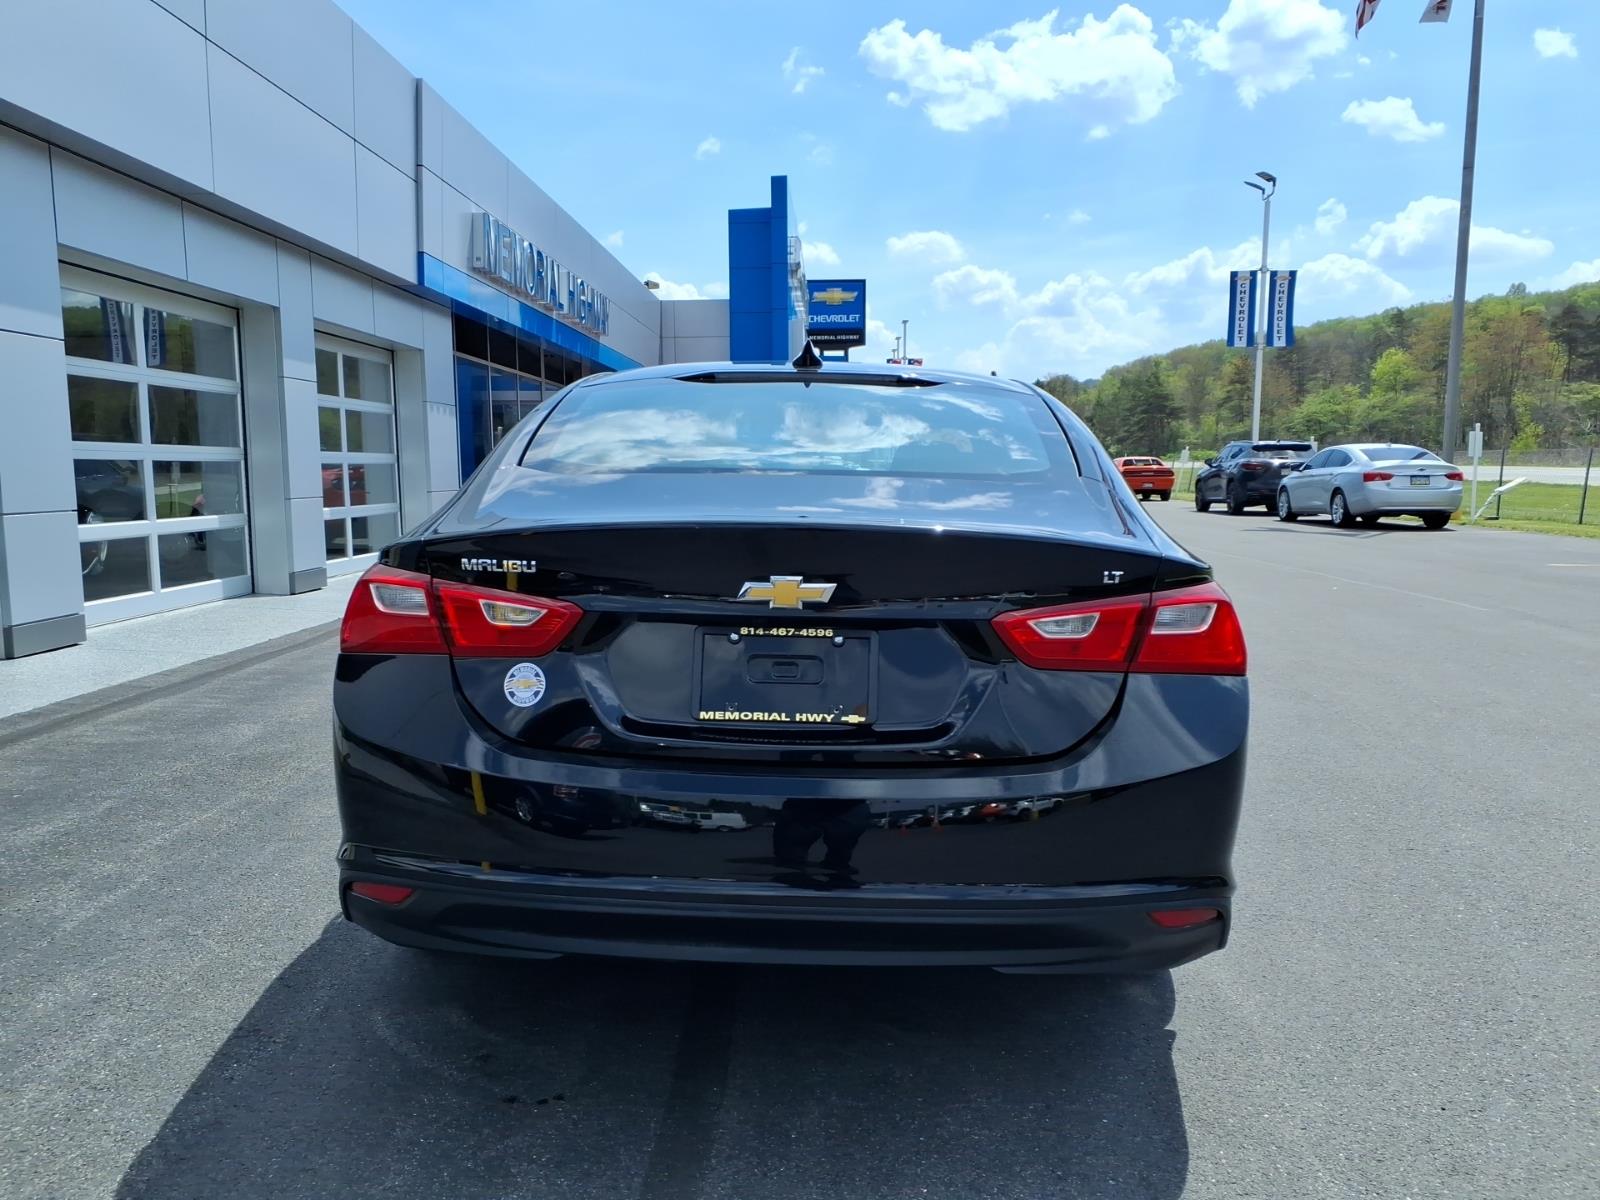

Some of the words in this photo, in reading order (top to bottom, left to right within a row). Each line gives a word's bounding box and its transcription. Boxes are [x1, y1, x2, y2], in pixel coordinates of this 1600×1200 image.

[1237, 282, 1247, 341] CHEVROLET
[1276, 282, 1285, 341] CHEVROLET
[808, 314, 860, 323] CHEVROLET
[461, 558, 536, 573] MALIBU
[1103, 571, 1125, 584] LT
[740, 627, 834, 637] 814-467-4596
[699, 711, 790, 722] MEMORIAL
[795, 713, 835, 723] HWY
